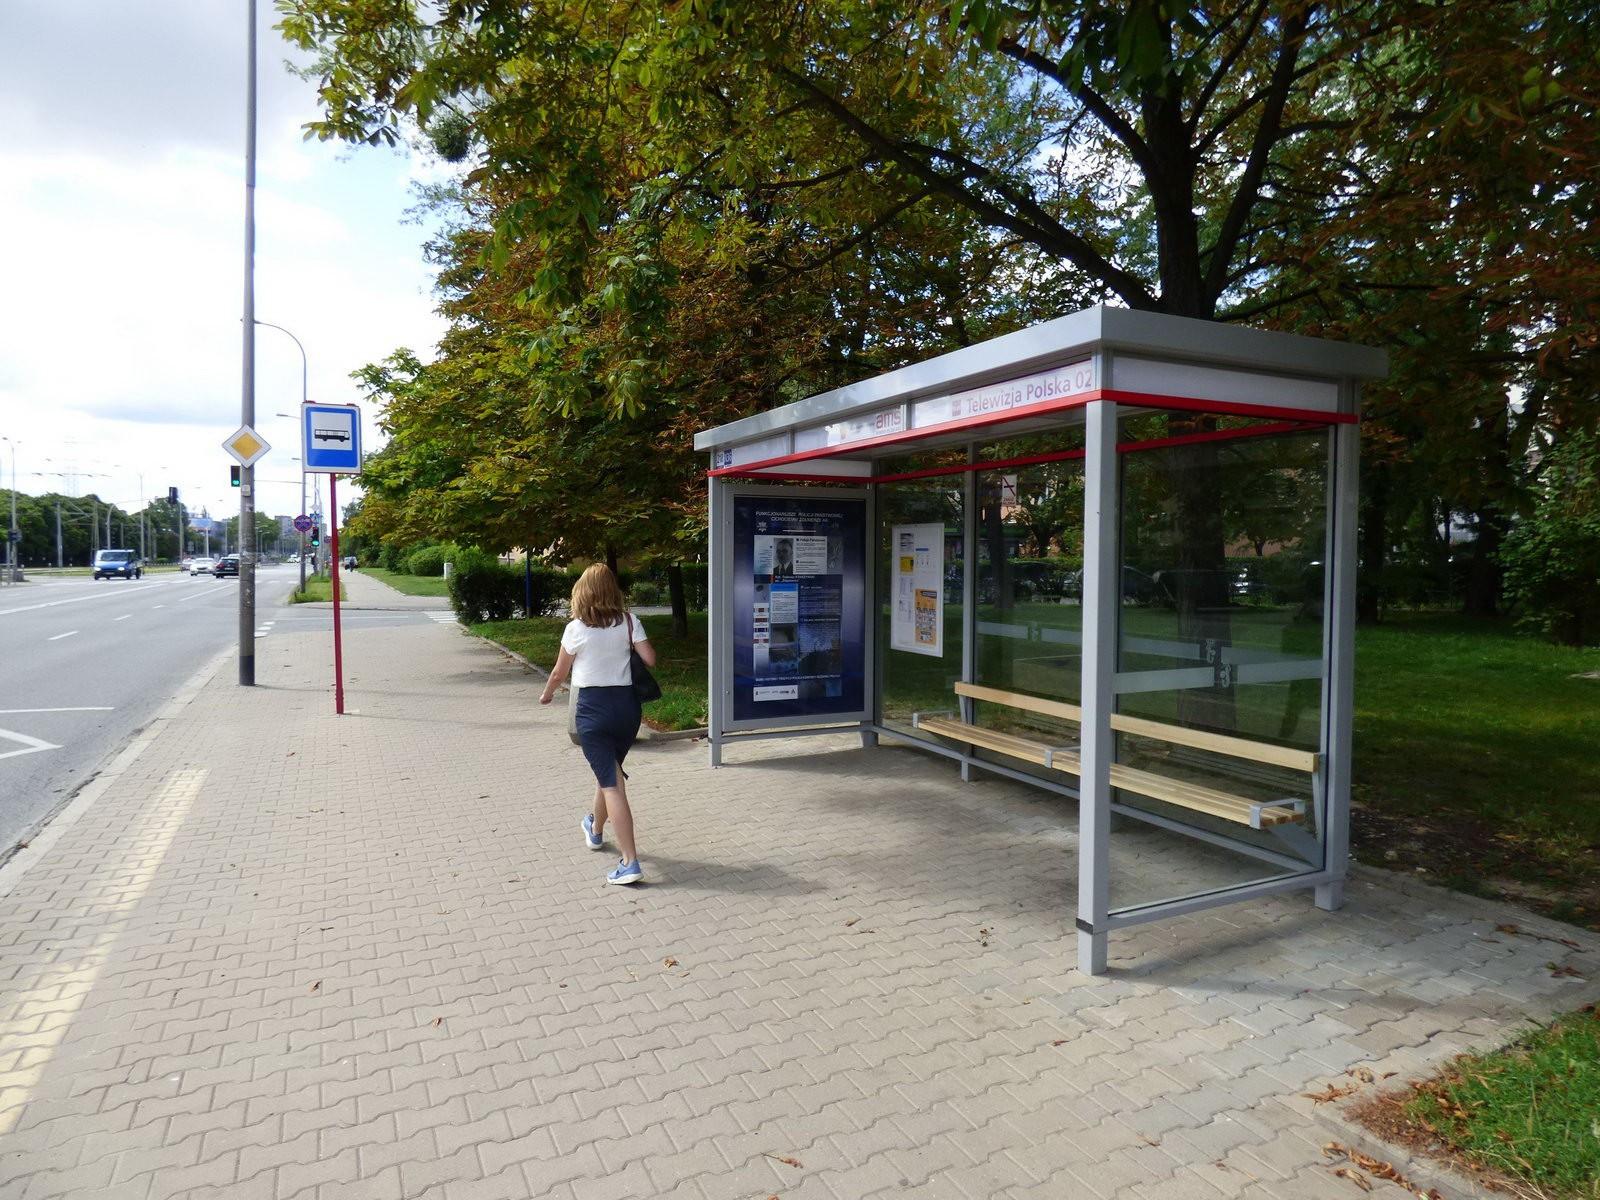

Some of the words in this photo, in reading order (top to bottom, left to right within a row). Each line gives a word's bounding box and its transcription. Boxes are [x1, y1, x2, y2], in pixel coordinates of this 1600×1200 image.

[967, 387, 1022, 413] Telewizja
[1026, 376, 1071, 399] Polska
[1075, 370, 1092, 390] 02
[875, 410, 901, 429] ams
